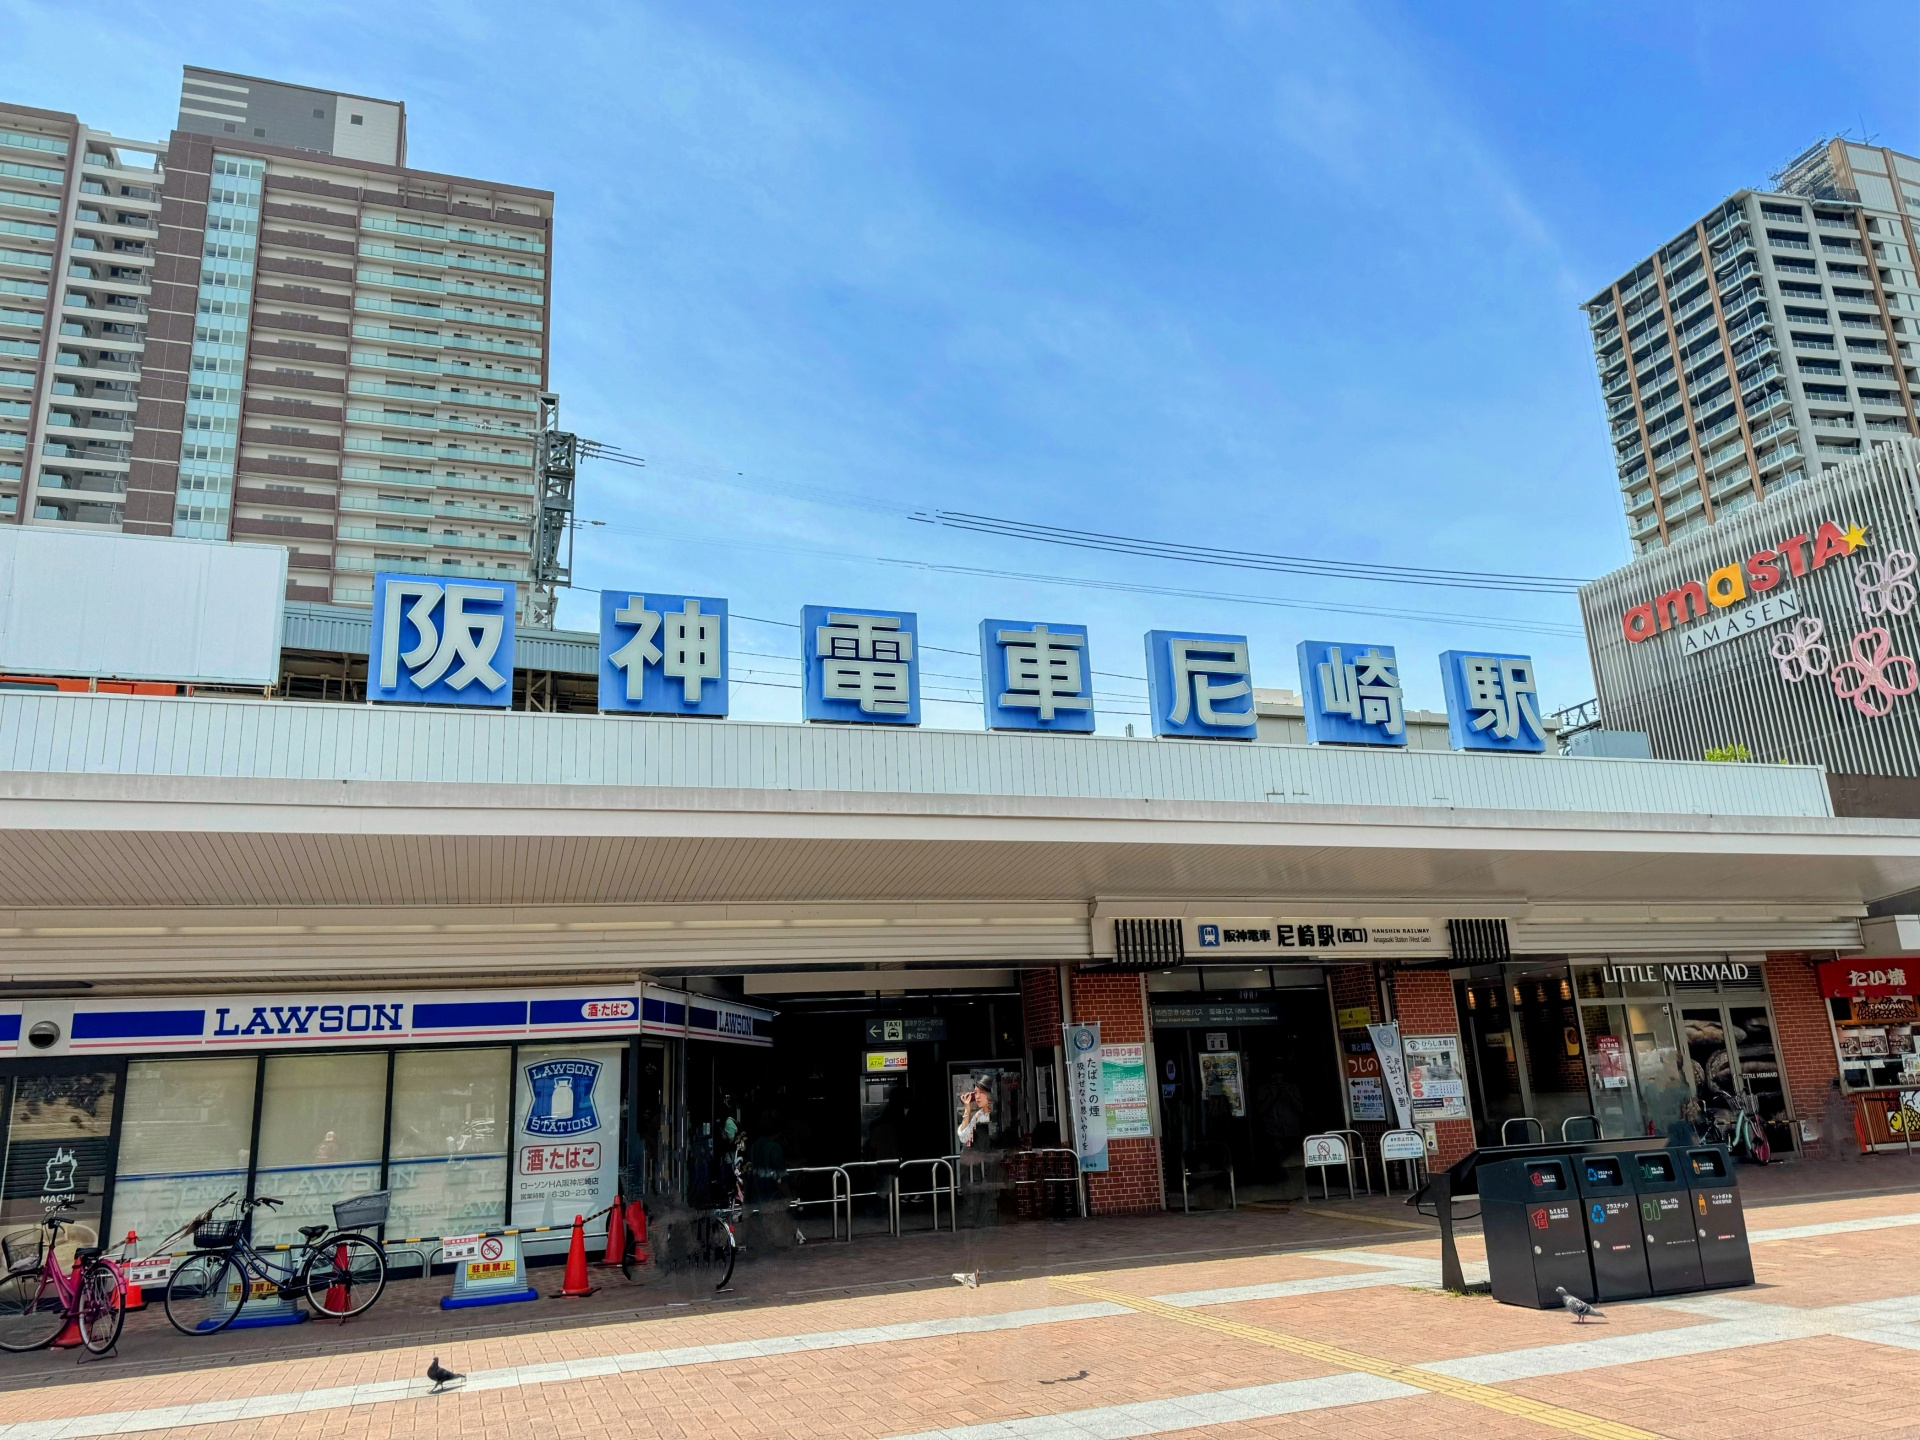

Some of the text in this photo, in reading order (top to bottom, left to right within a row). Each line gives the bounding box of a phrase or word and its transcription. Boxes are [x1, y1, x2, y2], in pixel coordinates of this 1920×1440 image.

[1685, 594, 1796, 652] AMASEN
[378, 579, 1548, 742] 阪神電車尼崎駅
[1223, 929, 1271, 943] 阪神電車
[1373, 936, 1394, 944] Amagasaki
[1603, 963, 1749, 983] LITTLE MERMAID
[1848, 968, 1907, 987] たい焼
[587, 1003, 629, 1017] 酒・たばこ
[1868, 1002, 1905, 1010] TAIYAKI
[214, 1003, 404, 1036] LAWSON
[718, 1010, 751, 1036] LAWSON
[532, 1063, 595, 1080] LAWSON
[1087, 1057, 1101, 1117] たばこの煙
[1076, 1062, 1088, 1151] 吸わせない思いやりを
[530, 1116, 592, 1133] STATION
[526, 1147, 595, 1172] 酒・たばこ
[54, 1170, 65, 1181] L
[520, 1177, 599, 1190] ローソンHA阪神尼崎店
[520, 1192, 545, 1200] 営業時間
[472, 1262, 511, 1274] 駐輪禁止
